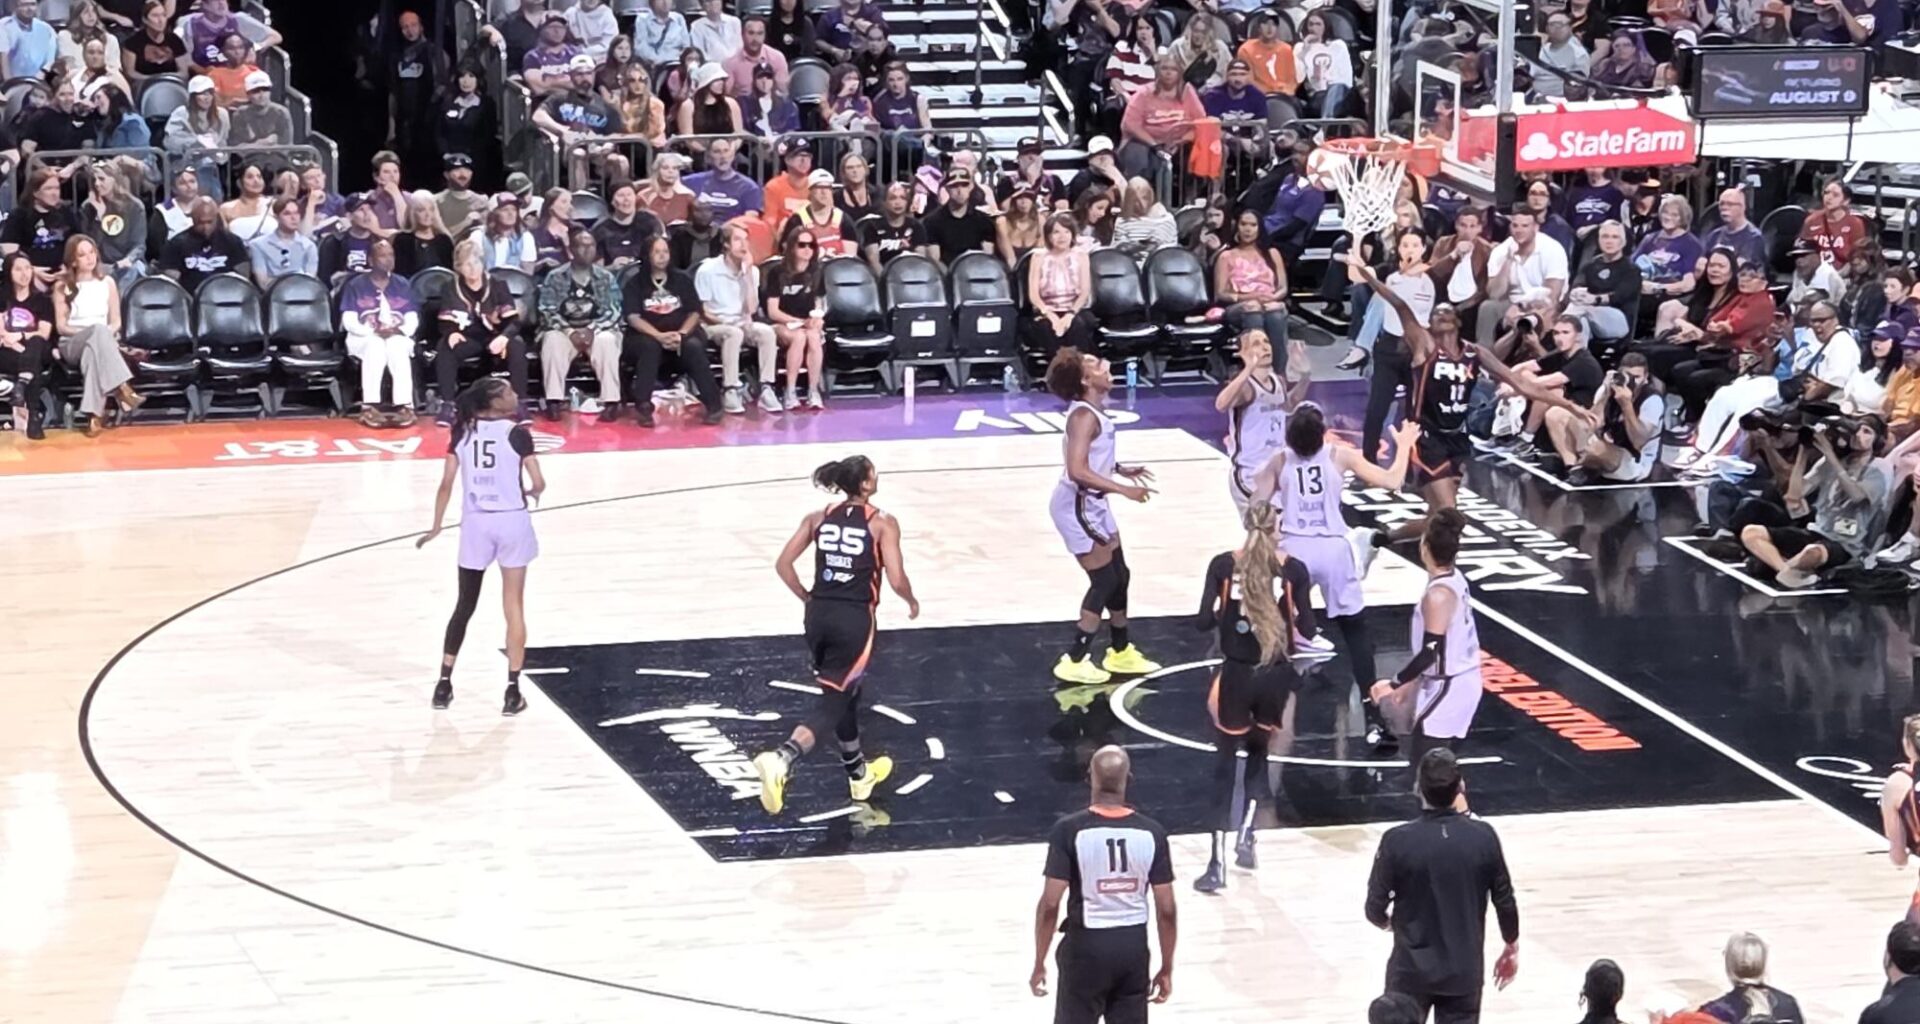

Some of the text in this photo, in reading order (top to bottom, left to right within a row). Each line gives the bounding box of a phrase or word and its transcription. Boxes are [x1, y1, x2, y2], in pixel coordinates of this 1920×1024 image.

[1769, 91, 1840, 104] AUGUST
[1433, 361, 1475, 383] PHX
[213, 435, 424, 462] AT&T
[473, 439, 497, 469] 15
[1296, 465, 1324, 497] 13
[818, 523, 867, 556] 25
[658, 719, 763, 801] WNBA
[1105, 837, 1129, 874] 11
